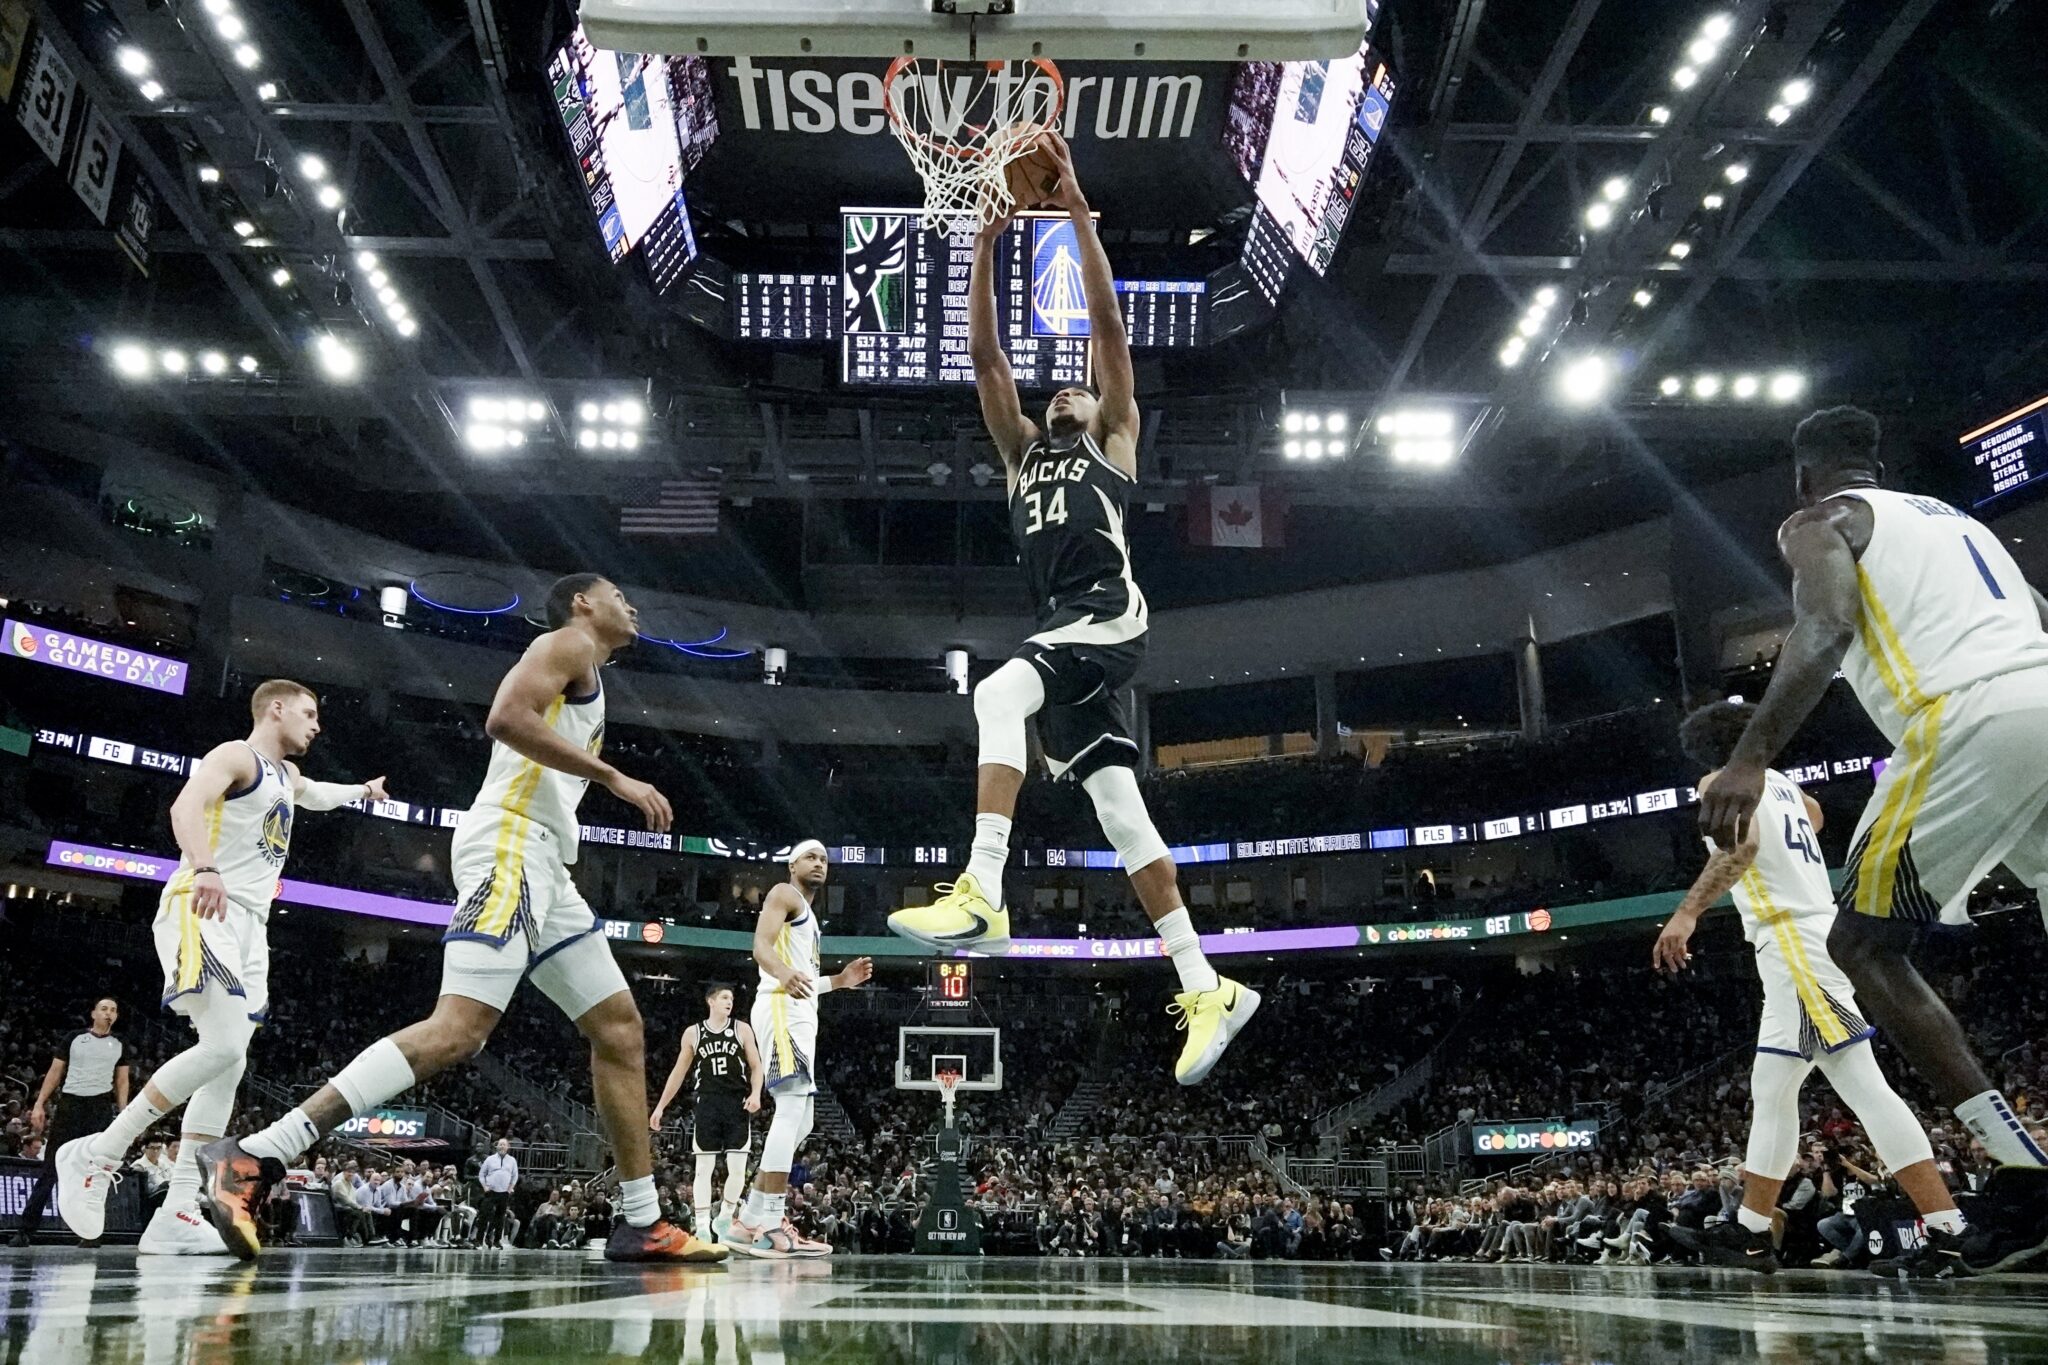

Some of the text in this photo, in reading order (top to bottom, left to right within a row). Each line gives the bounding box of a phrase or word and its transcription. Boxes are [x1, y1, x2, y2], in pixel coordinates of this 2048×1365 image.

[1014, 234, 1021, 246] 2
[1014, 249, 1021, 261] 4
[916, 262, 1021, 277] 10 OFF 11
[948, 280, 968, 292] DEF
[1010, 278, 1023, 291] 22
[916, 292, 1022, 306] 15 12
[741, 306, 749, 316] 12
[1127, 314, 1135, 324] 15
[740, 317, 750, 326] 22
[762, 318, 770, 327] 17
[914, 322, 926, 334] 34
[740, 328, 750, 337] 34
[762, 328, 771, 338] 27
[784, 328, 791, 338] 12
[856, 336, 875, 348] 53.7
[880, 337, 889, 348] %
[940, 339, 965, 352] FIELD
[1010, 339, 1038, 351] 30/83
[1056, 340, 1072, 352] 36.1
[1076, 340, 1084, 352] %
[880, 352, 889, 363] %
[903, 352, 927, 363] 7/22
[1012, 354, 1036, 365] 14/41
[1055, 354, 1072, 366] 34.1
[1075, 354, 1084, 367] %
[880, 366, 889, 378] %
[940, 369, 960, 380] FREE
[1052, 369, 1072, 381] 83.3
[1075, 369, 1084, 382] %
[1981, 424, 2023, 451] REBOUNDS
[1974, 431, 2034, 466] OFF REBOUNDS
[1990, 449, 2023, 470] BLOCKS
[1020, 458, 1090, 497] BUCKS
[1993, 461, 2025, 482] STEALS
[1993, 470, 2029, 493] ASSISTS
[1025, 486, 1068, 535] 34
[1962, 534, 2006, 599] 1
[45, 634, 179, 677] GAMEDAY IS
[50, 649, 170, 687] GUAC DAY
[56, 735, 74, 748] PM
[103, 743, 121, 759] FG
[141, 751, 180, 772] 53.7%
[1785, 764, 1825, 783] 36.1%
[1834, 759, 1861, 775] 8:33
[1646, 794, 1668, 808] 3PT
[381, 801, 400, 817] TOL
[416, 809, 424, 822] 4
[1561, 800, 1628, 824] FT 83.3%
[1423, 828, 1467, 841] FLS 3
[1493, 818, 1535, 835] TOL 2
[578, 825, 672, 850] AUKEE BUCKS
[1237, 834, 1361, 858] GOLDEN STATE WARRIORS
[1784, 814, 1821, 865] 40
[842, 847, 865, 863] 105
[916, 847, 947, 863] 8:19
[1047, 850, 1066, 865] 84
[605, 921, 631, 938] GET
[1486, 916, 1511, 935] GET
[1008, 945, 1075, 956] OODFOODS
[940, 964, 967, 977] 8:19
[945, 977, 963, 997] 10
[698, 1040, 738, 1059] BUCKS
[711, 1056, 728, 1076] 12
[334, 1117, 417, 1136] DFOODS
[928, 1232, 937, 1240] GET
[1869, 1239, 1884, 1248] TNT
